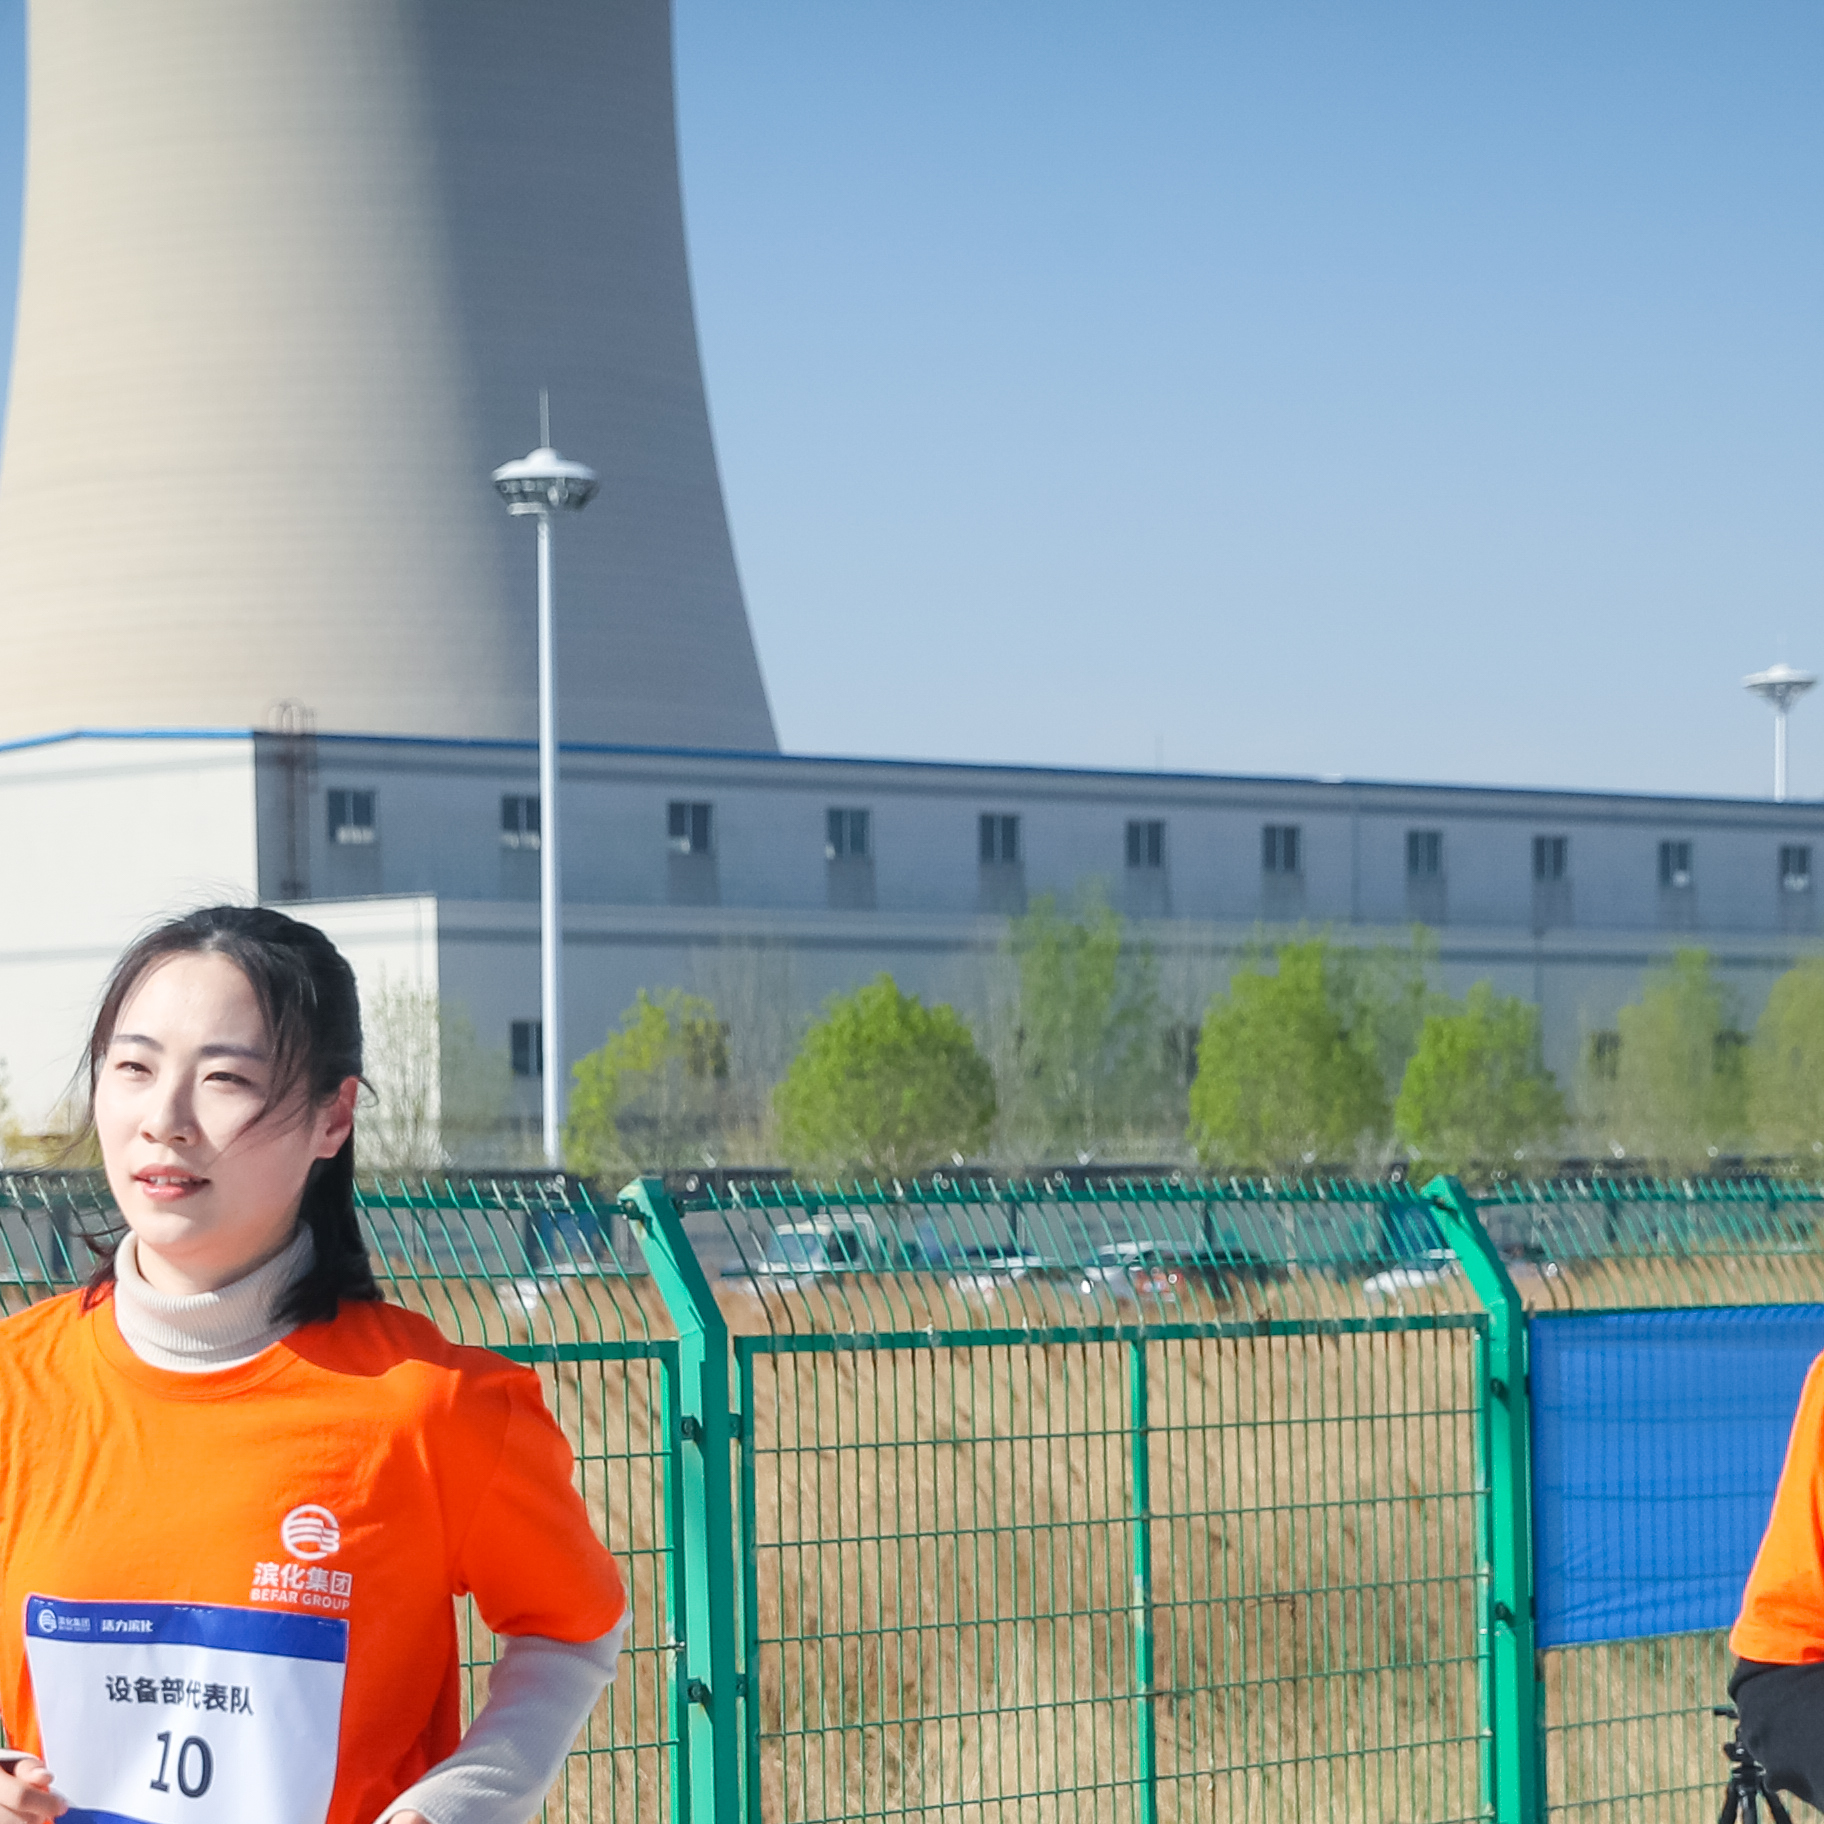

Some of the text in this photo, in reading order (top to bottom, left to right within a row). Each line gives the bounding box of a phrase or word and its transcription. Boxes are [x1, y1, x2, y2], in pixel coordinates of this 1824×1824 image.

[252, 1562, 353, 1597] 滨化集团
[250, 1588, 350, 1610] BEFAR GROUP
[105, 1675, 255, 1716] 设备部代表队
[150, 1730, 214, 1798] 10
